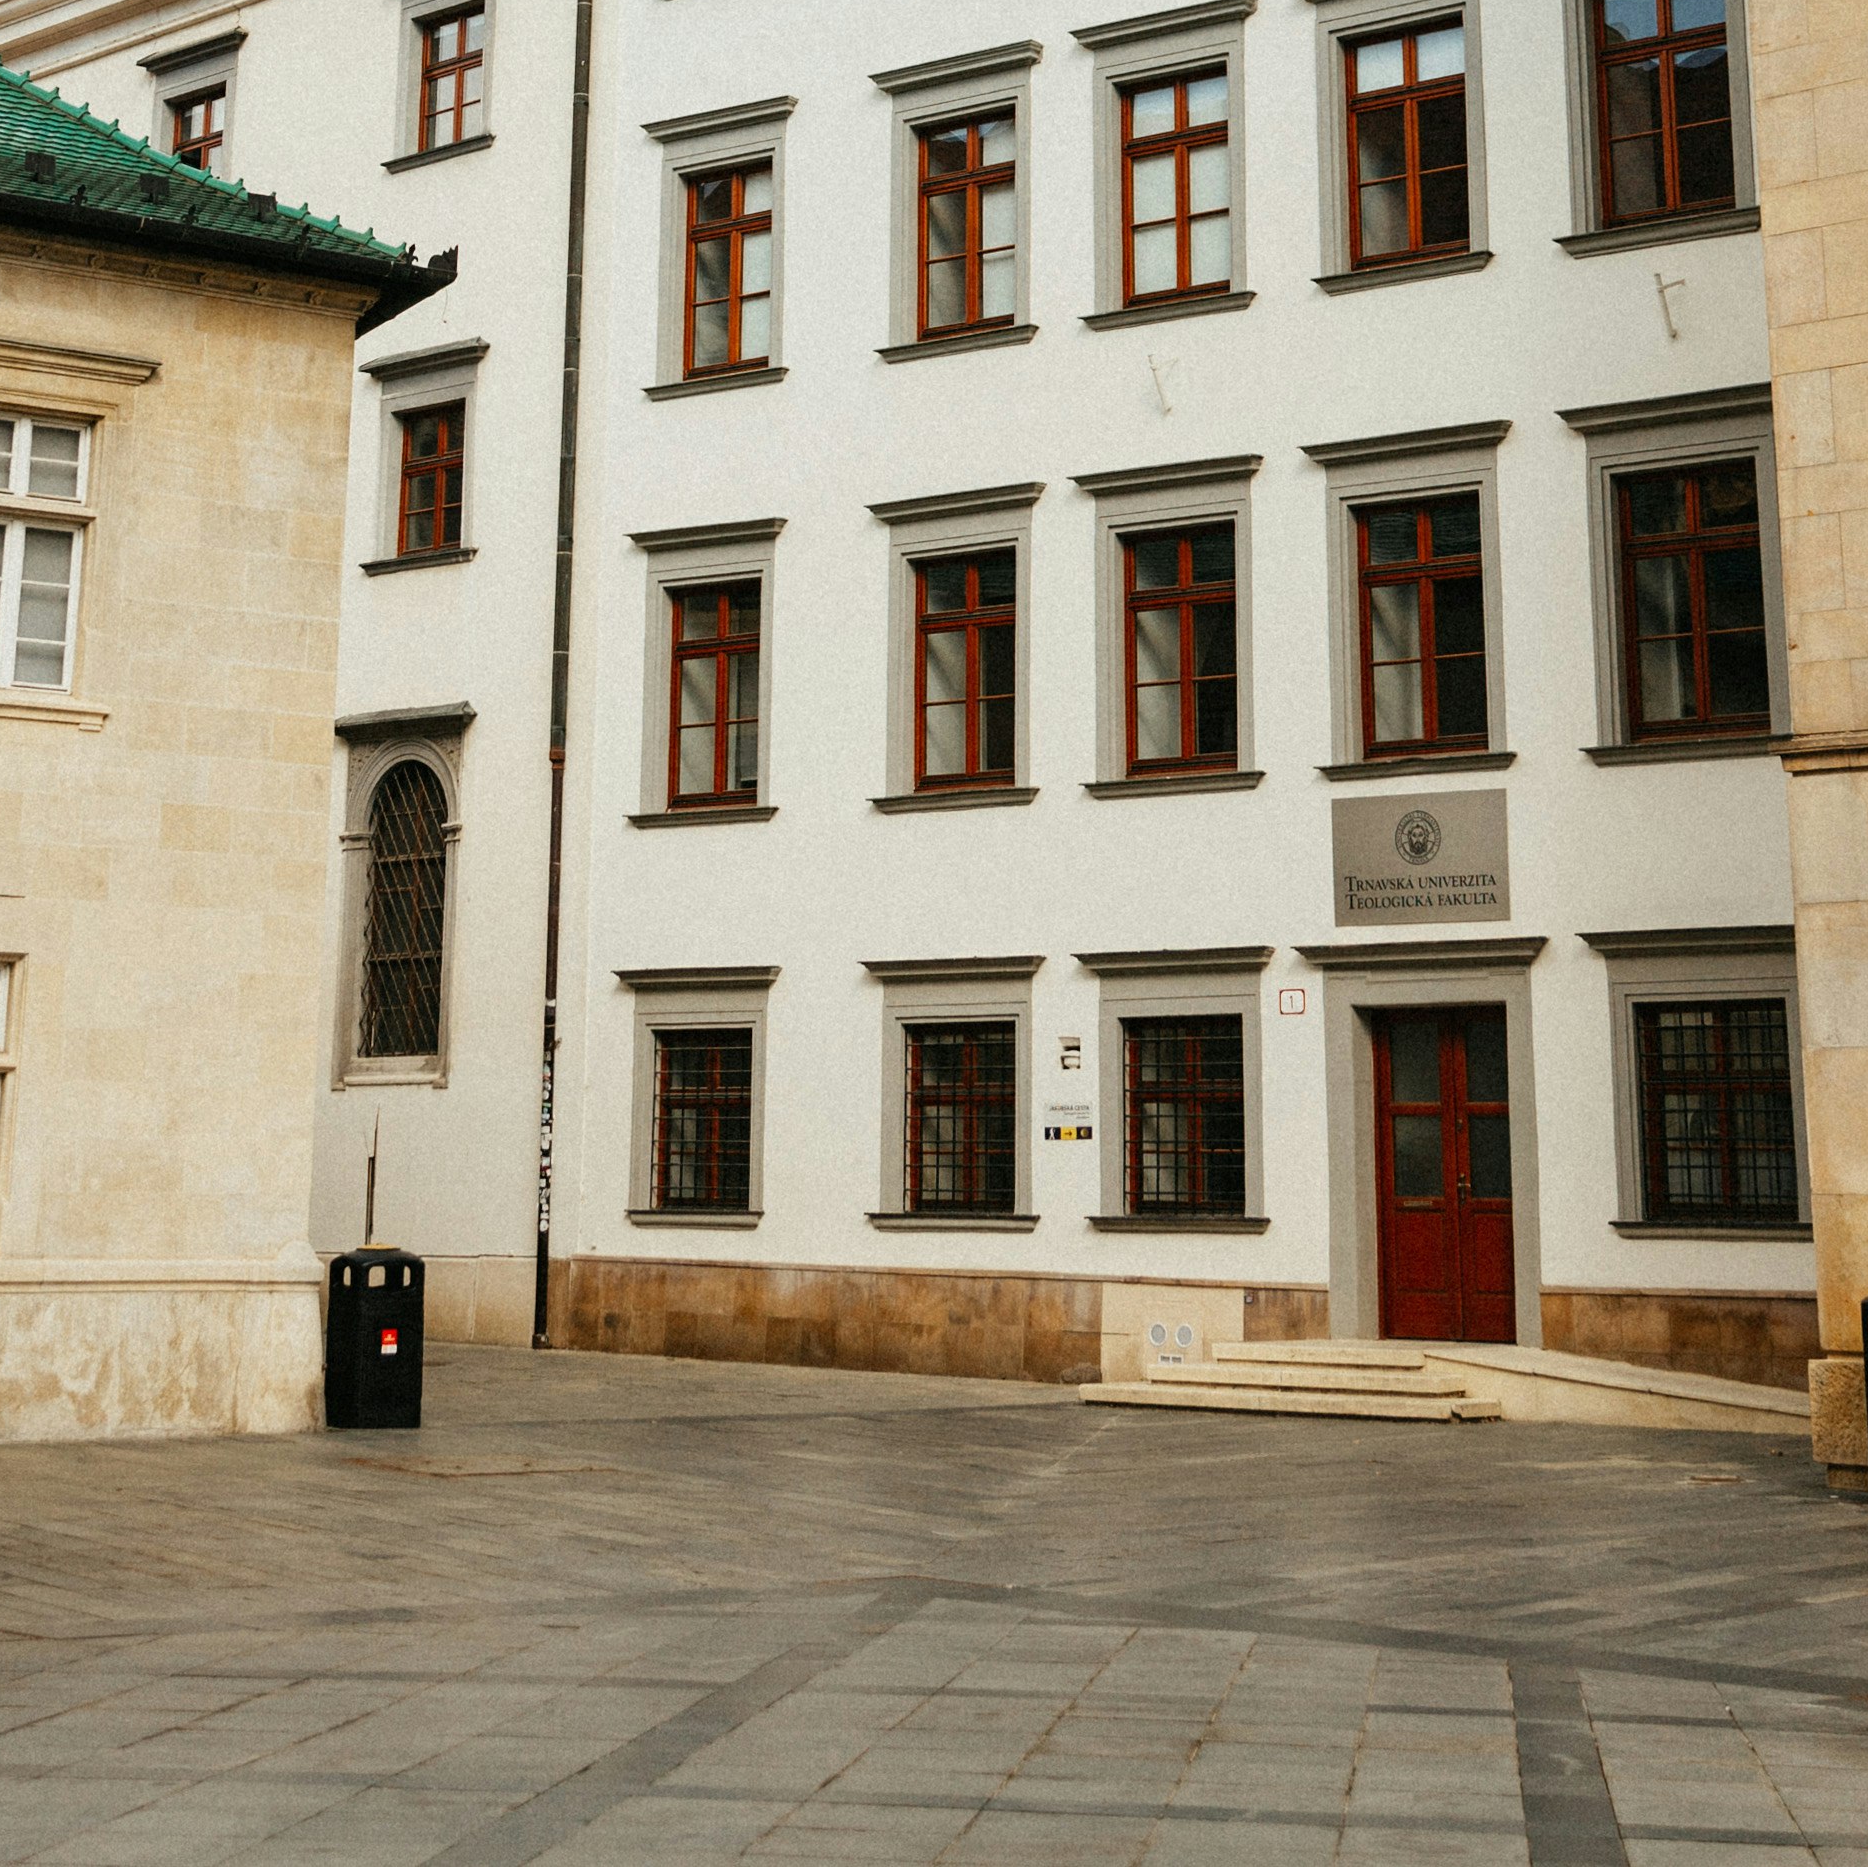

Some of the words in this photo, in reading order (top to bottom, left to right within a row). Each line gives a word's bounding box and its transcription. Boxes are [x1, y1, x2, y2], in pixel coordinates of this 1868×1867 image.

[1343, 875, 1415, 893] TRNAVSKÁ
[1418, 874, 1497, 889] UNIVERZITA
[1344, 892, 1434, 911] TEOLOGICKÁ
[1437, 892, 1497, 907] FAKULTA
